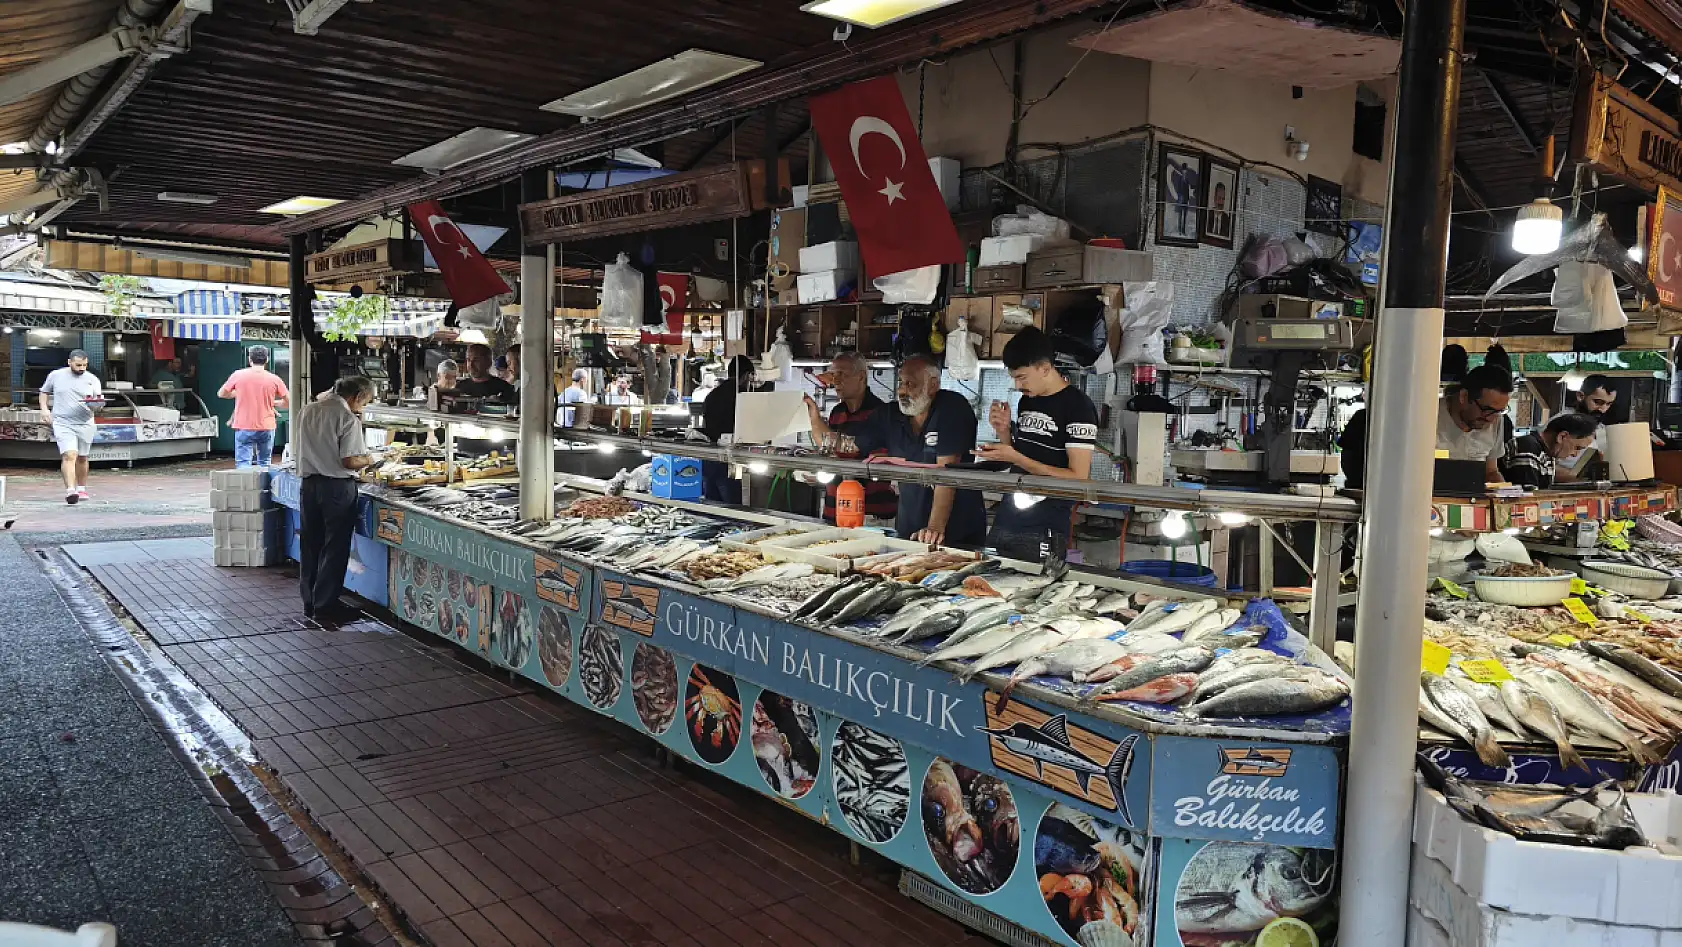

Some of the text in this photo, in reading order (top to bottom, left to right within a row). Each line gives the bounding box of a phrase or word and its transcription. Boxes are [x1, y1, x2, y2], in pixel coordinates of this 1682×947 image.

[407, 518, 454, 556] GÜRKAN
[456, 538, 528, 584] BALIKÇILIK
[665, 601, 965, 737] GÜRKAN BALIKÇILIK
[1206, 775, 1300, 803] Gürkan
[1173, 796, 1327, 840] Balıkçılık
